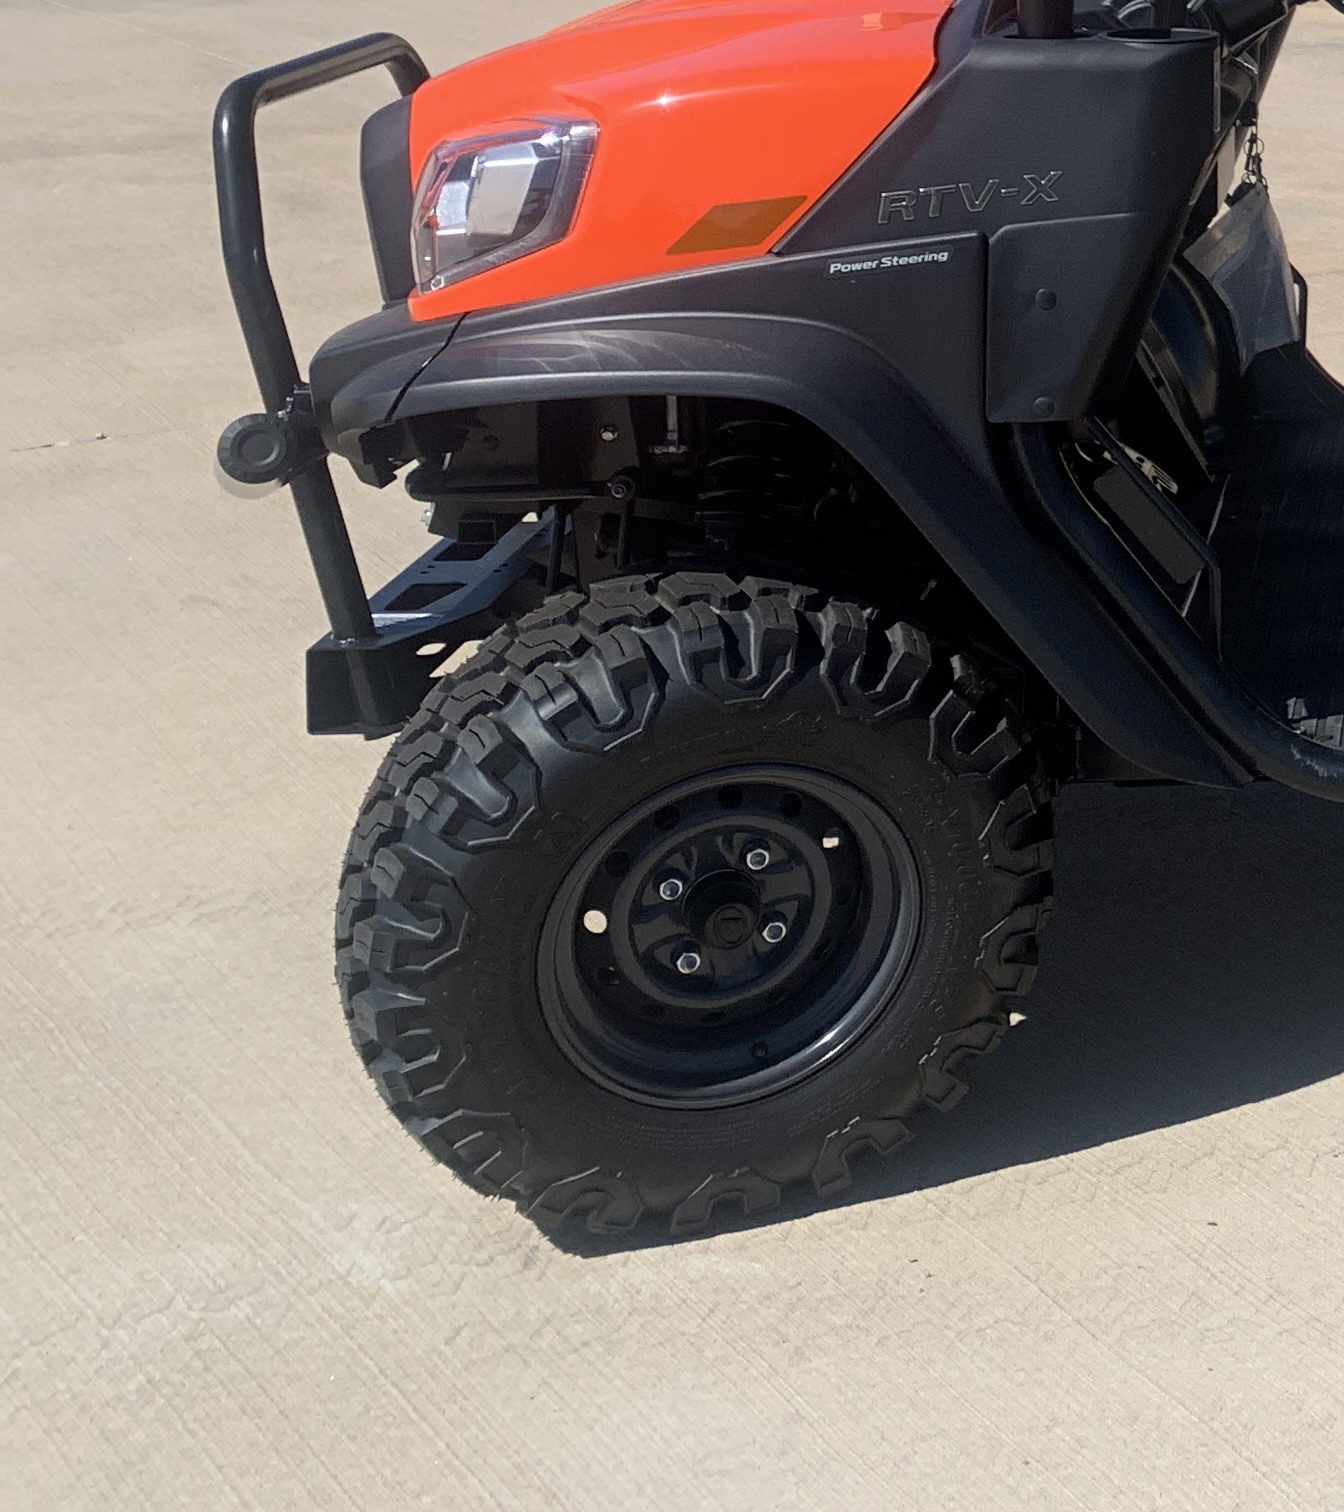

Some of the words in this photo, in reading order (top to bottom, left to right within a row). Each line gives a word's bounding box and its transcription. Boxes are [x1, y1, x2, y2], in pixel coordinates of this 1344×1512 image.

[877, 171, 1063, 224] RTV-X
[829, 258, 879, 275] Power
[880, 250, 949, 268] Steering
